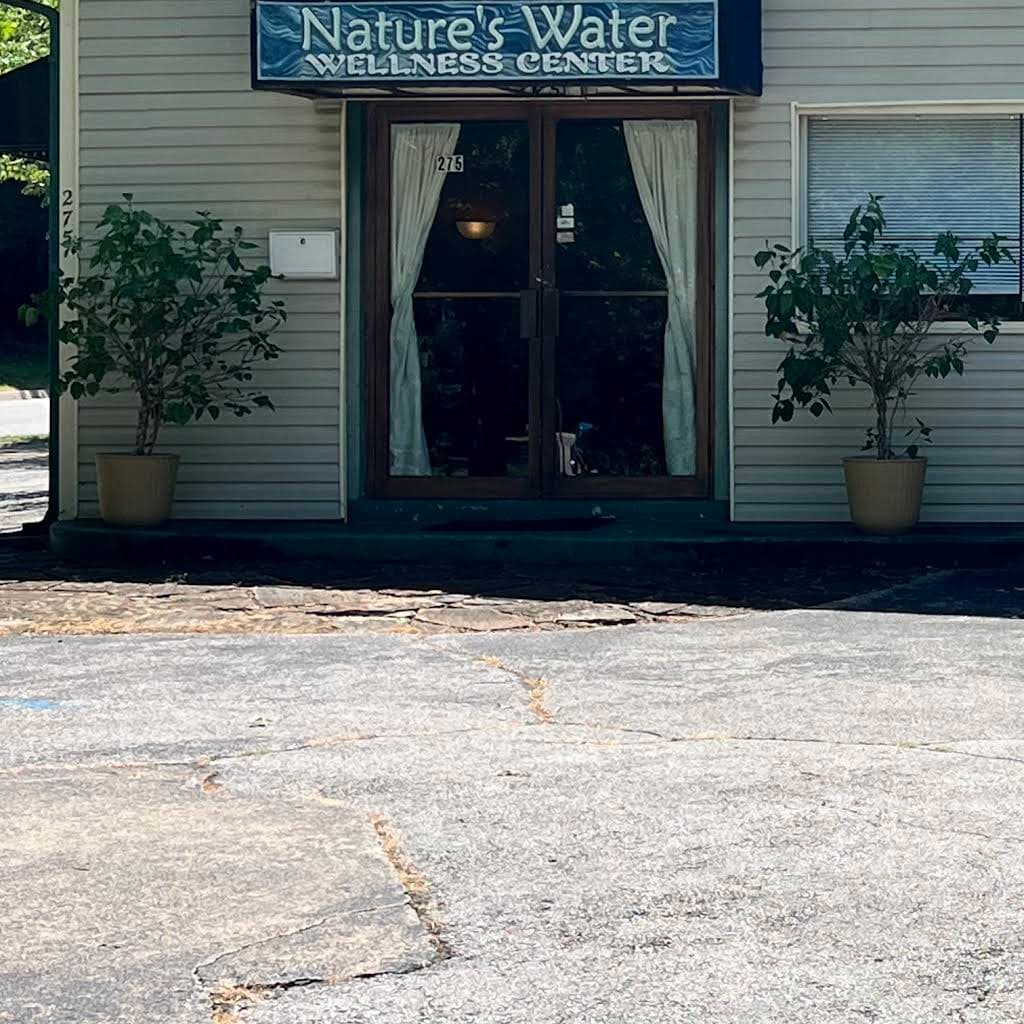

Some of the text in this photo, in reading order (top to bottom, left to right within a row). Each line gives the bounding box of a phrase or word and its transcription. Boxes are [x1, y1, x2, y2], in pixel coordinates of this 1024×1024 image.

[300, 4, 678, 51] Nature's Water
[305, 51, 671, 76] WELLNESS CENTER
[438, 156, 462, 171] 275
